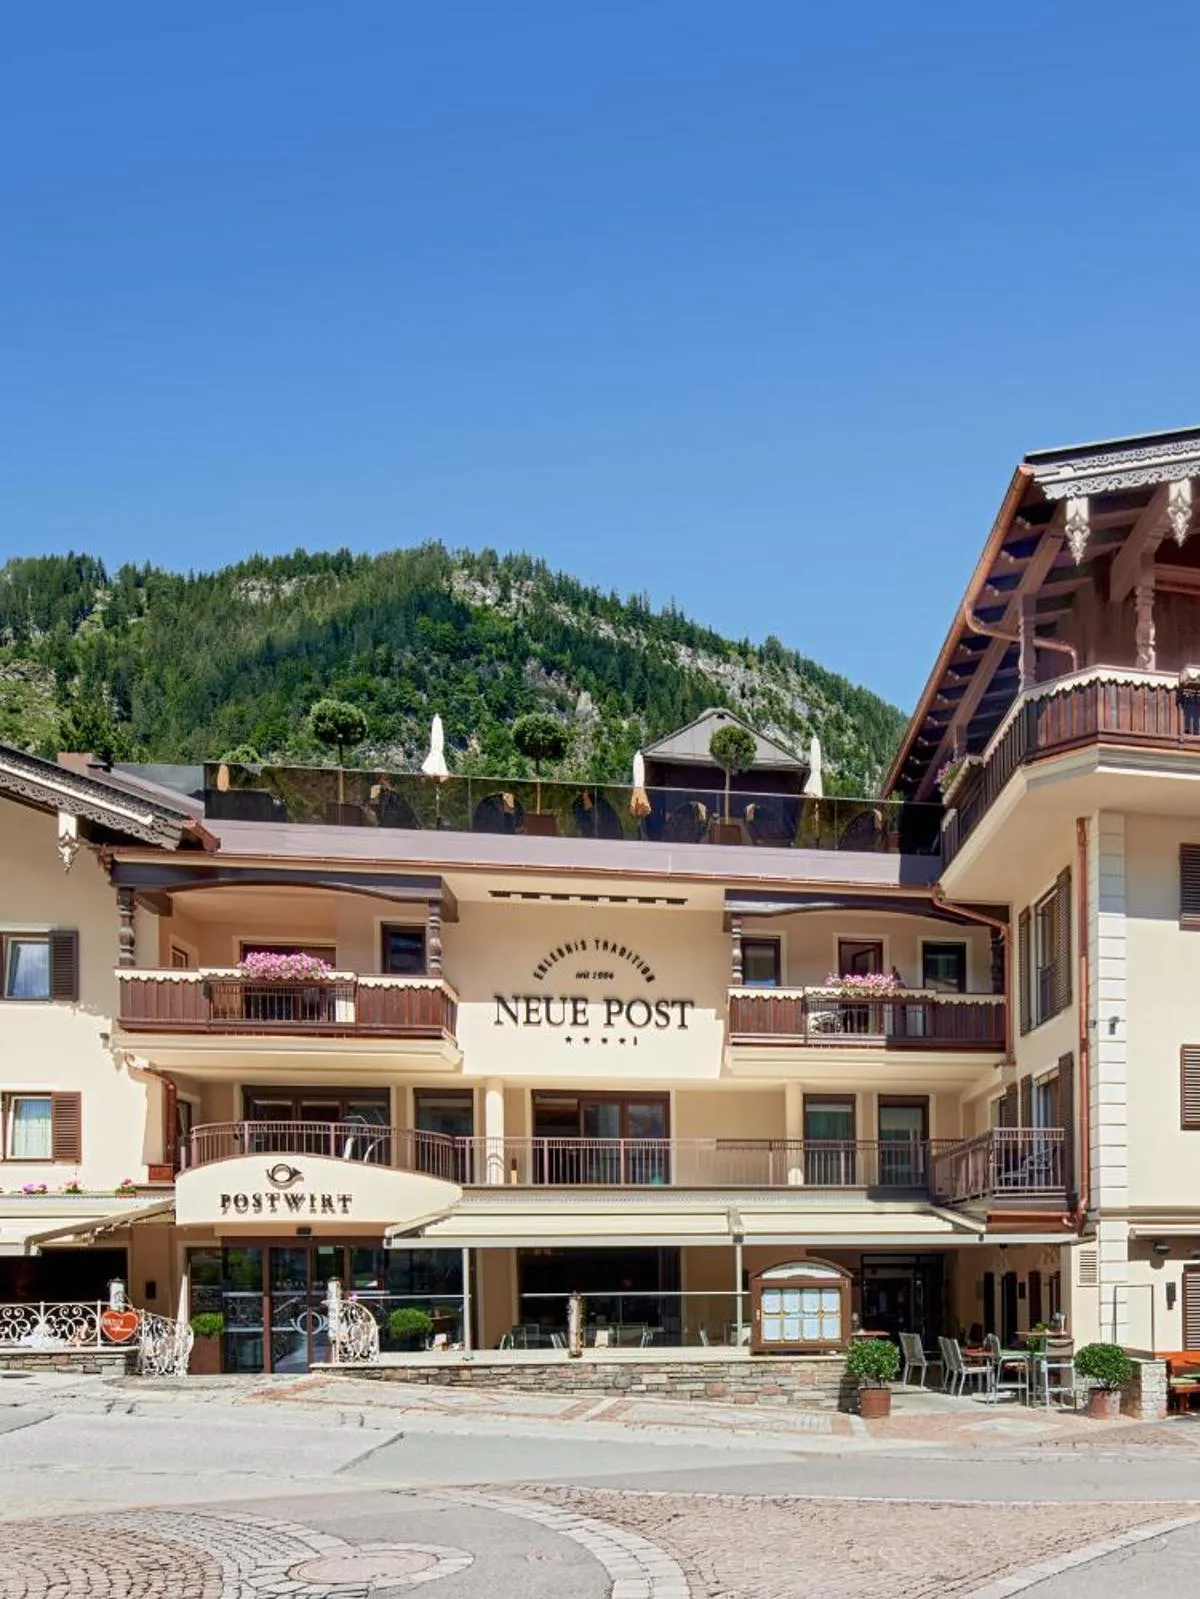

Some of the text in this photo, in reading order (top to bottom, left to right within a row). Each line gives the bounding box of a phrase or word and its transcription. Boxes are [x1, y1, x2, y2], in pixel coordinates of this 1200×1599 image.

[533, 939, 656, 983] ERLEBNIS TRADITION
[493, 994, 695, 1030] NEUE POST
[219, 1191, 352, 1211] POSTWIRT
